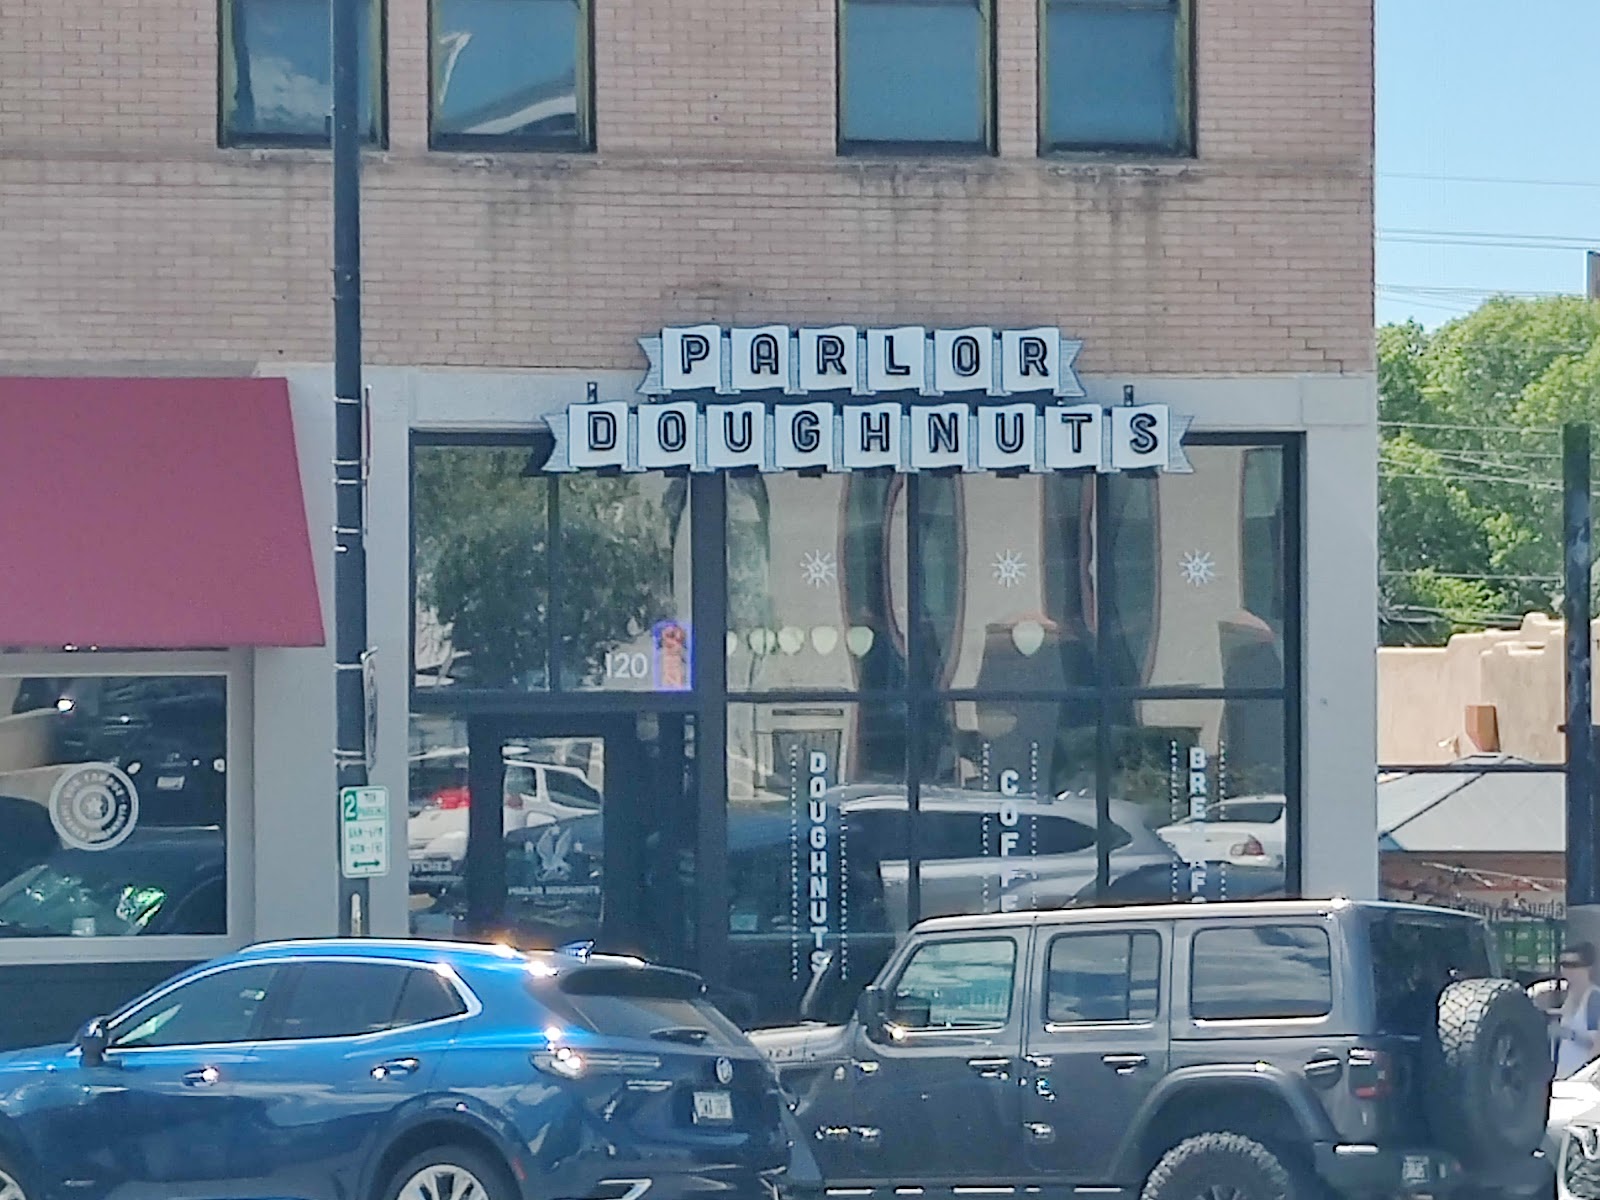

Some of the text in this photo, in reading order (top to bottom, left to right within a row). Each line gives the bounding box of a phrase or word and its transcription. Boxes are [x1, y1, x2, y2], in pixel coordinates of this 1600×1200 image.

[680, 333, 1048, 377] PARLOR
[587, 409, 1160, 455] DOUGHNUTS
[604, 651, 648, 679] 120
[344, 793, 357, 818] 2
[809, 750, 829, 973] DOUGHNUTS
[1000, 768, 1020, 913] COFFE
